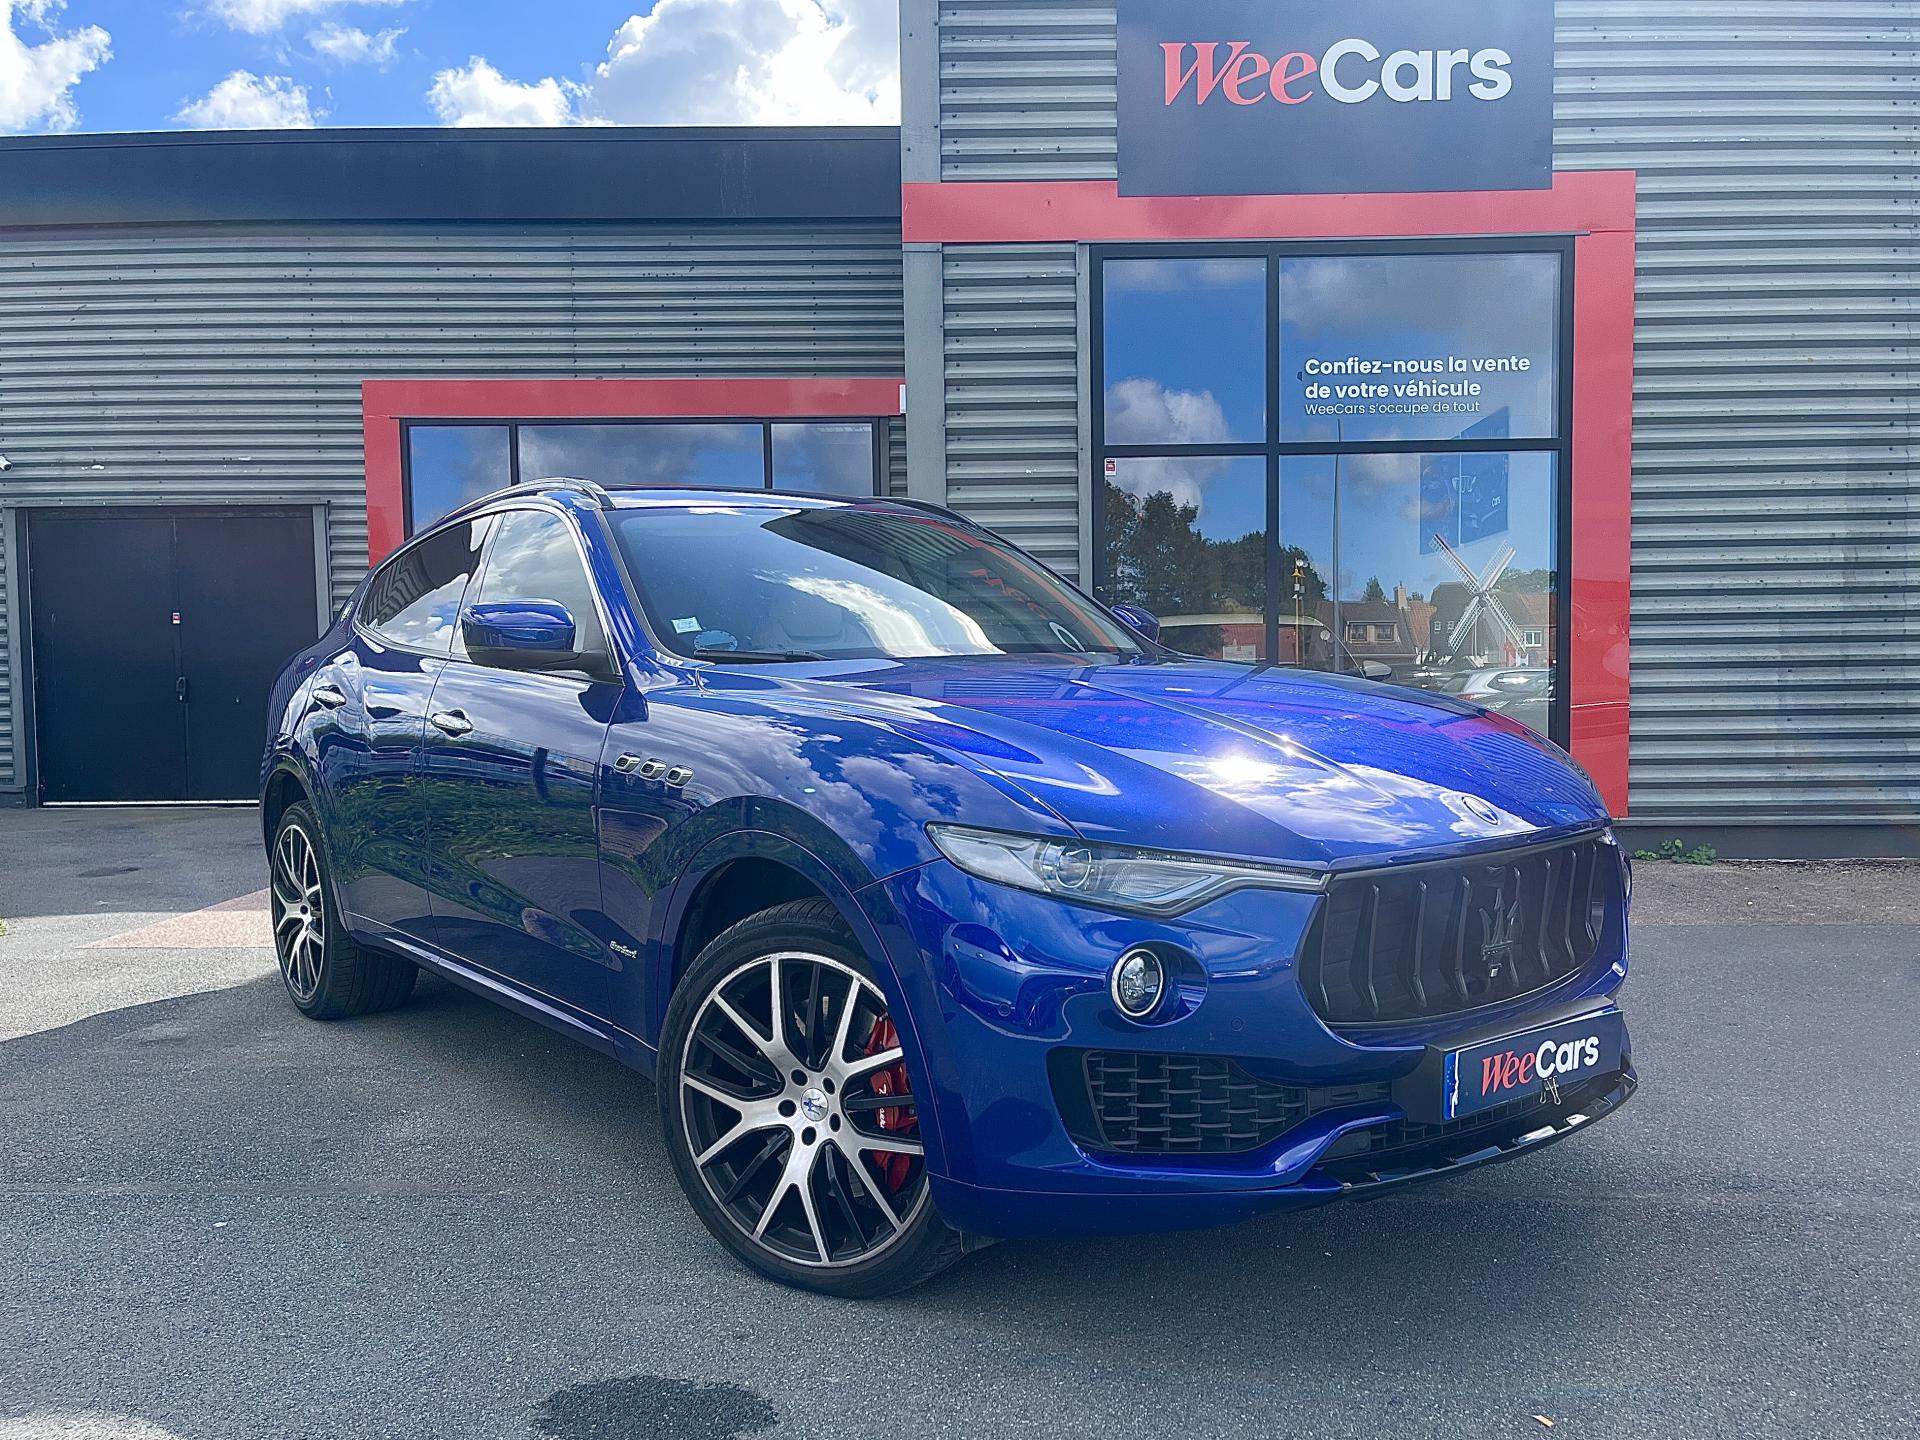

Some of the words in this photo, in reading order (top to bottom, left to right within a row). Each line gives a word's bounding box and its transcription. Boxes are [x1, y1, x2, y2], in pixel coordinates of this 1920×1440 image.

[1159, 38, 1513, 106] WeeCars
[1305, 355, 1444, 374] Confiez-nous
[1448, 355, 1467, 373] la
[1472, 356, 1531, 372] vente
[1305, 382, 1331, 399] de
[1335, 381, 1389, 399] votre
[1393, 379, 1482, 398] véhicule
[1304, 403, 1366, 415] WeeCars
[1369, 403, 1429, 415] s'occupe
[1432, 401, 1450, 413] de
[1453, 400, 1480, 412] tout
[1482, 1036, 1599, 1097] WeeCars
